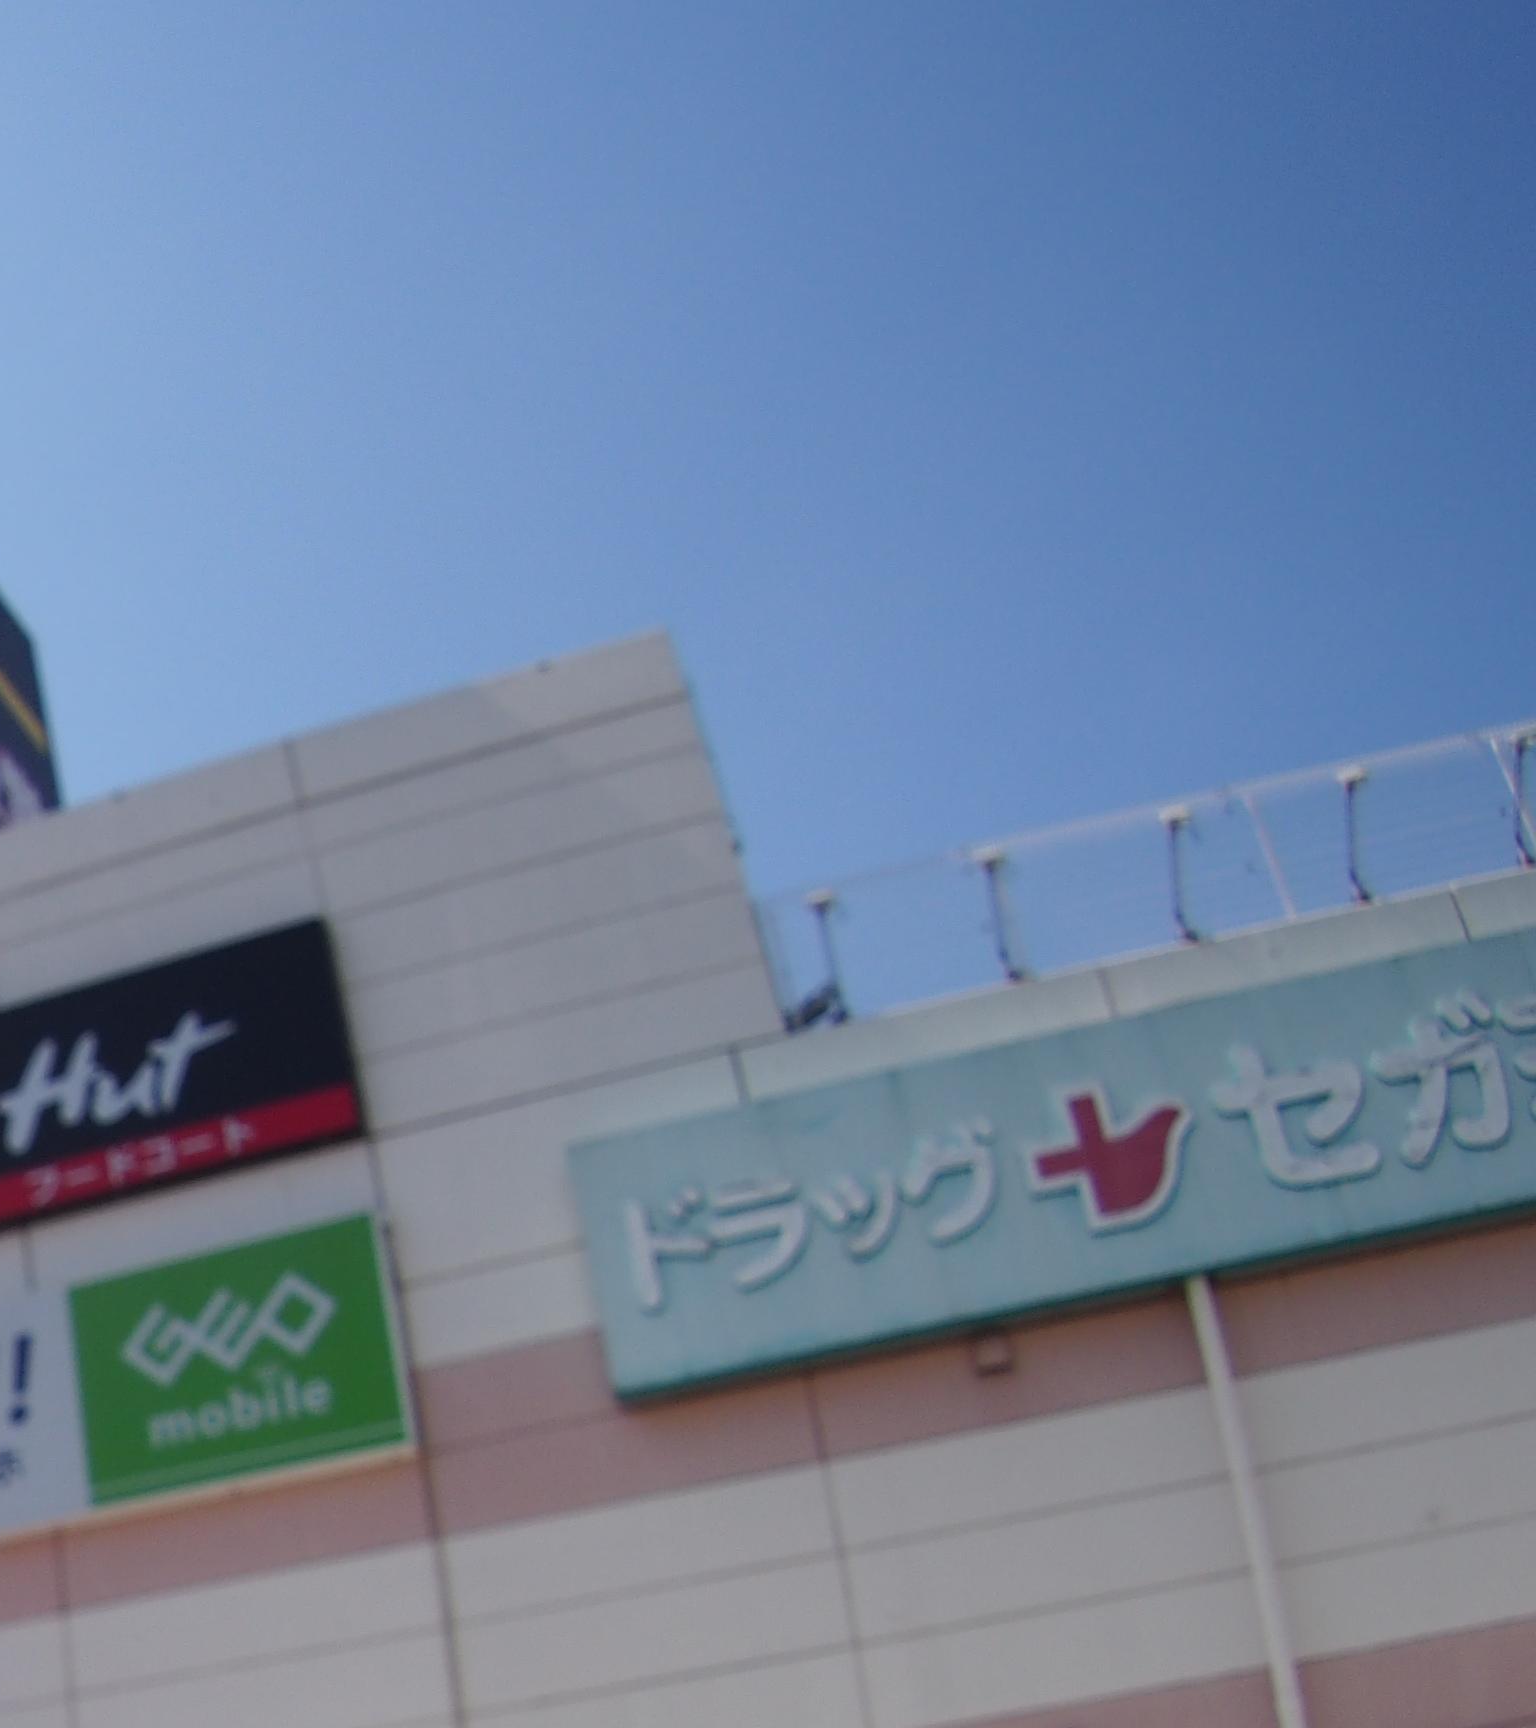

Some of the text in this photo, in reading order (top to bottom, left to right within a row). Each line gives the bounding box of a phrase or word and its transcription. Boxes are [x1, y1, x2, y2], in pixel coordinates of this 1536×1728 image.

[24, 1116, 256, 1208] フードコート
[625, 1112, 1002, 1314] ドラッグ
[146, 1362, 333, 1450] mobile
